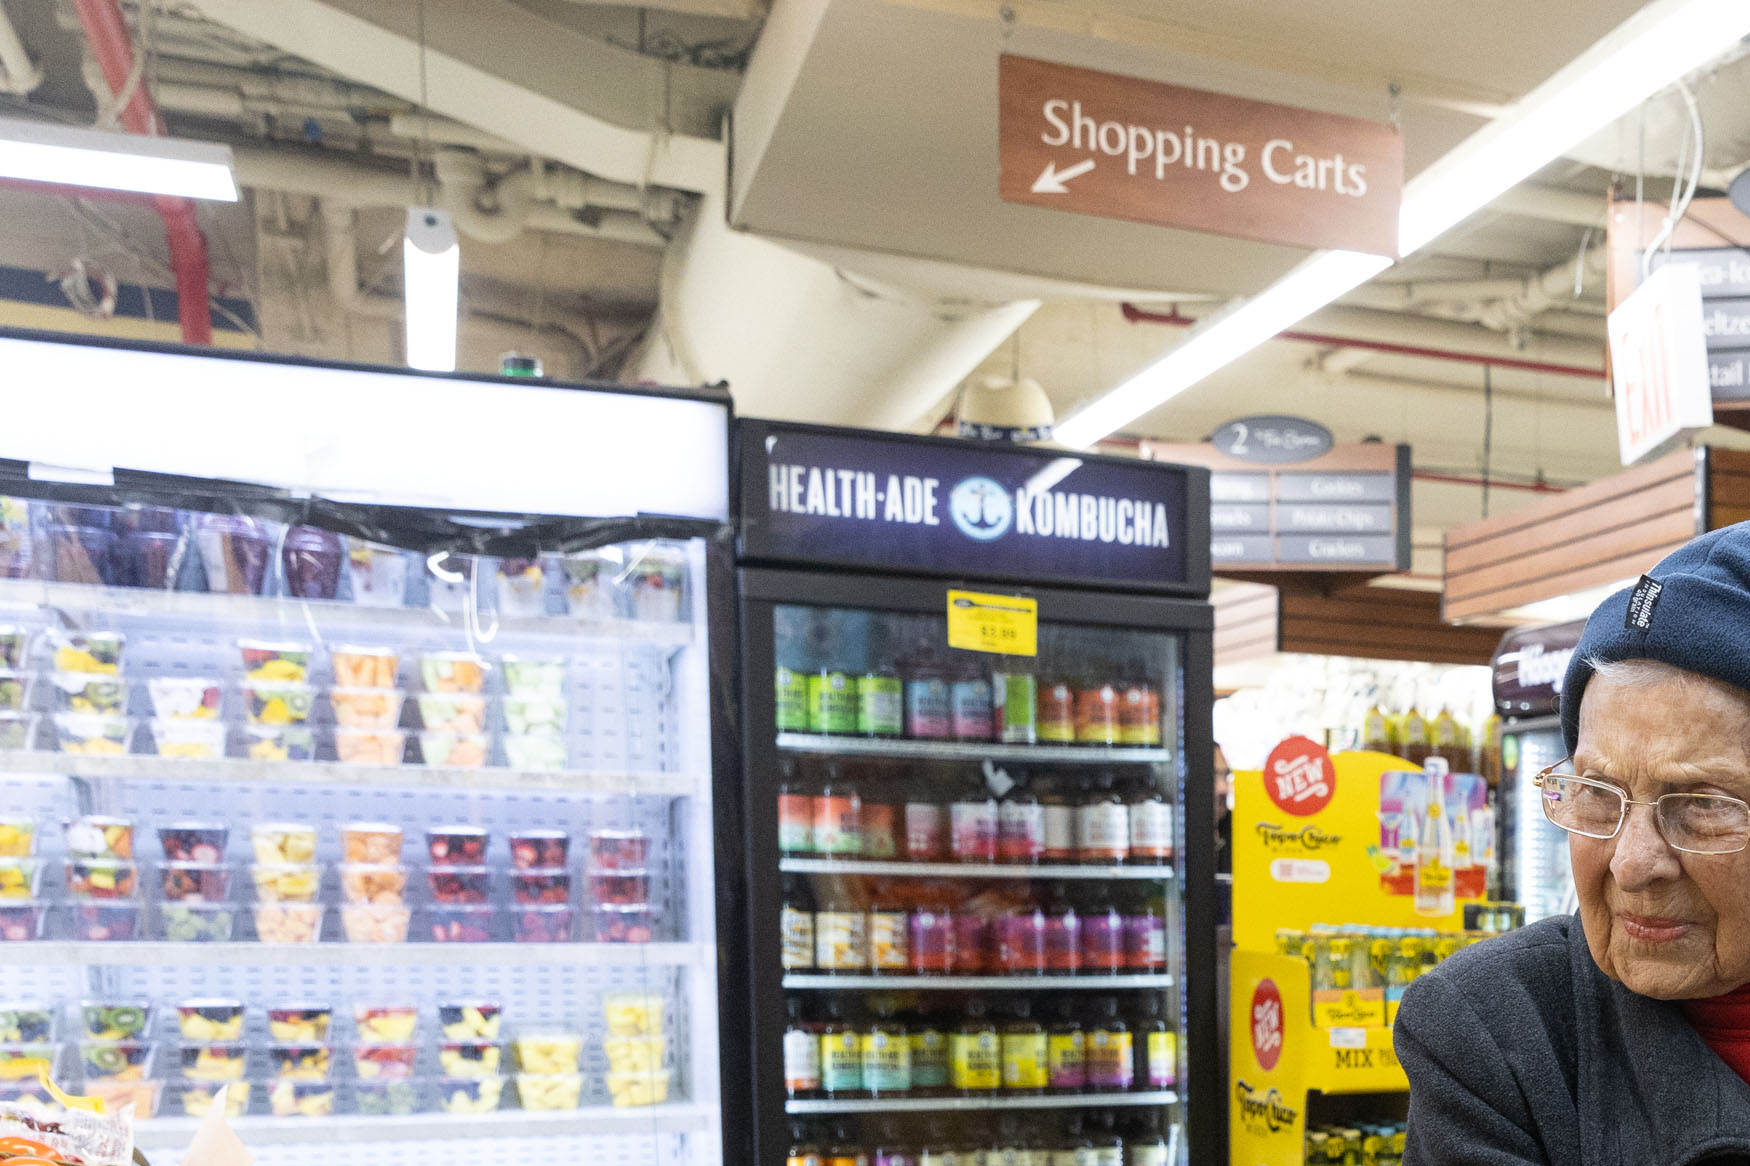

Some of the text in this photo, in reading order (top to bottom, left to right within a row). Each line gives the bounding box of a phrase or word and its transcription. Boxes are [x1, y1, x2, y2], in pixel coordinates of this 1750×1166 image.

[1040, 99, 1369, 198] Shopping Carts
[1230, 422, 1249, 455] 2
[1015, 487, 1170, 549] KOMBUCHA
[1636, 582, 1663, 628] Thinsulate
[1274, 757, 1324, 801] NEW
[1256, 822, 1344, 850] Topo Chico
[1335, 1049, 1374, 1069] MIX
